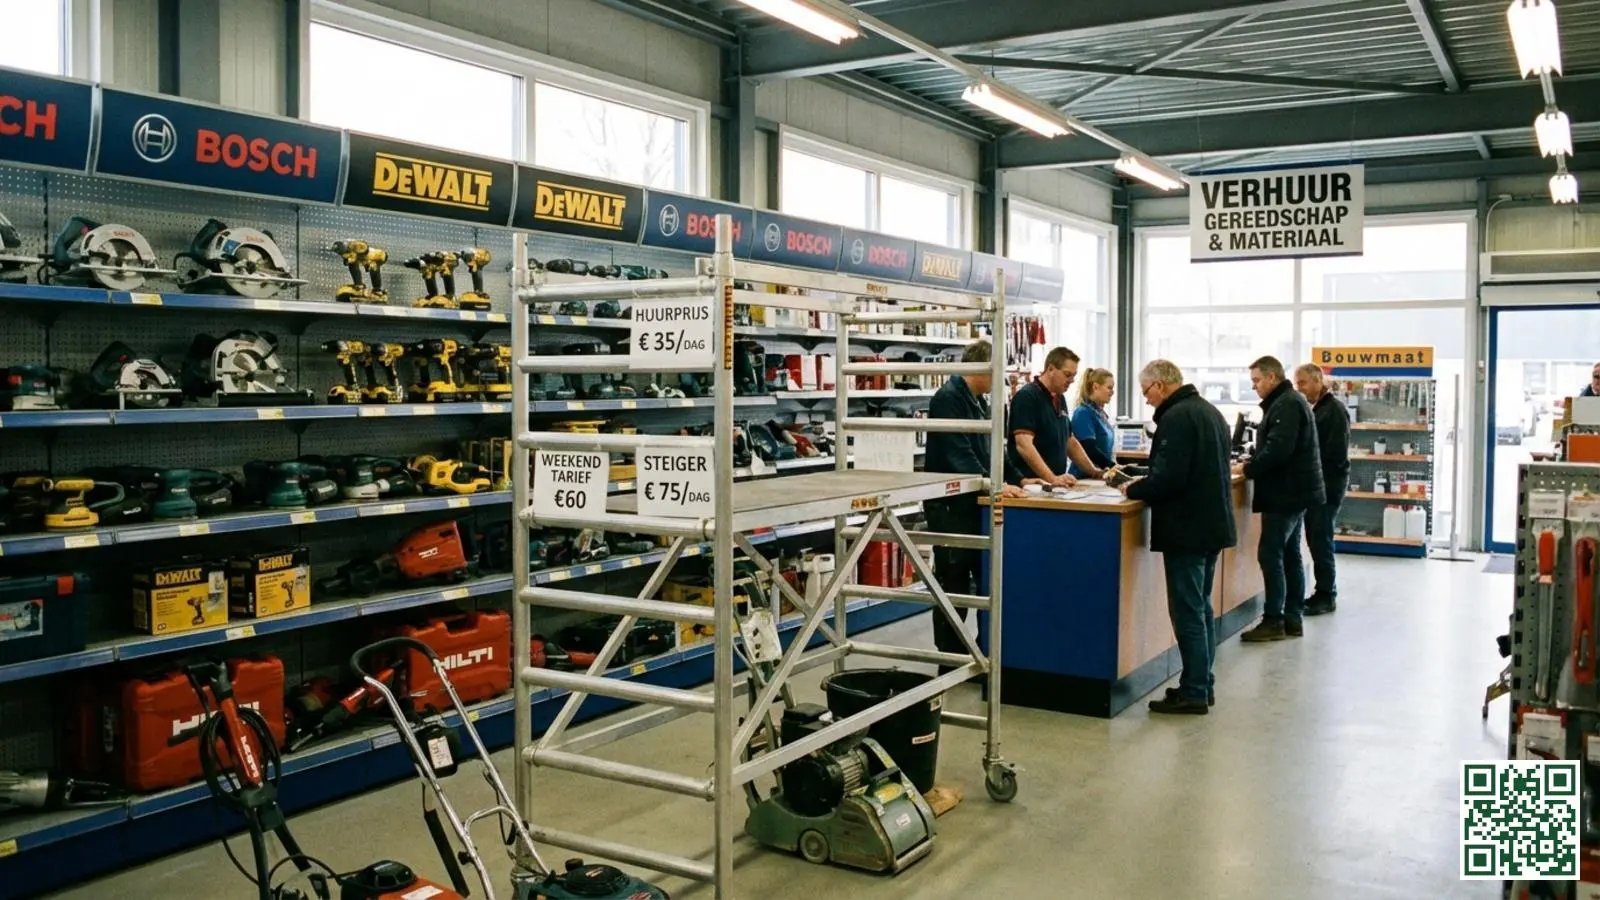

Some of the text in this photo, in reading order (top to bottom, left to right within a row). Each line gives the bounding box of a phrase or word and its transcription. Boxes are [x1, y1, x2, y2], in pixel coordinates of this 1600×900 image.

[195, 129, 317, 178] BOSCH
[1201, 172, 1352, 209] VERHUUR
[1205, 206, 1348, 230] GEREEDSCHAP
[786, 230, 832, 256] BOSCH
[1209, 228, 1344, 251] & MATERIAAL
[636, 306, 709, 322] HUURPRIJS
[639, 333, 650, 351] €
[1322, 350, 1424, 364] Bouwmaat
[541, 454, 601, 469] WEEKEND
[644, 456, 707, 472] STEIGER
[551, 469, 592, 484] TARIEF
[554, 489, 586, 509] €60
[645, 482, 655, 500] €
